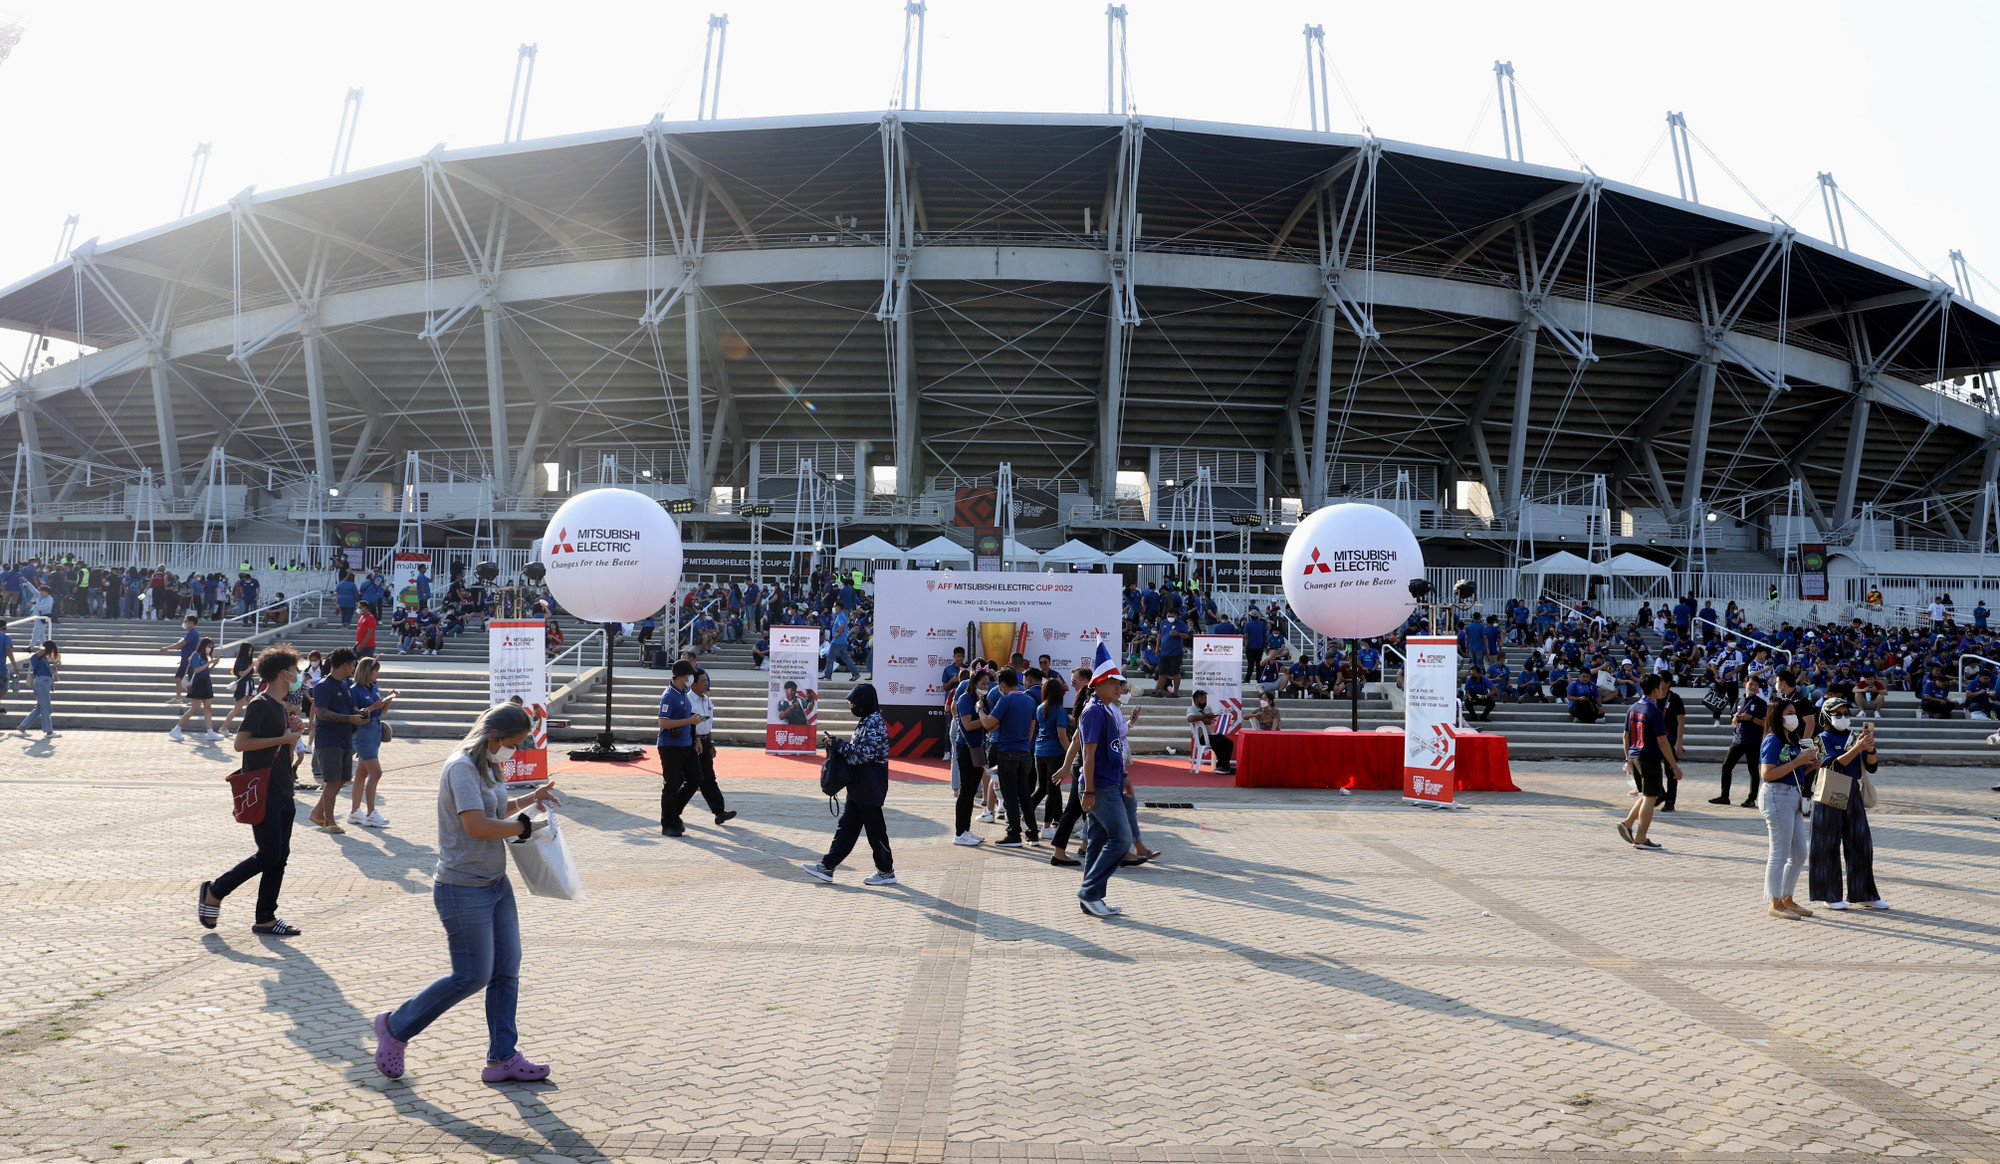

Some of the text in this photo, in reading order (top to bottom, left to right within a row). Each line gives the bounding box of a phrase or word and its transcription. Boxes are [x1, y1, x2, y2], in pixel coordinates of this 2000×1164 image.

[577, 529, 640, 540] MITSUBISHI
[577, 542, 631, 553] ELECTRIC
[1334, 550, 1397, 561] MITSUBISHI
[551, 560, 578, 569] Changes
[580, 559, 592, 567] for
[612, 558, 639, 566] Better
[690, 558, 730, 566] MITSUBISHI
[1334, 561, 1389, 572] ELECTRIC
[1304, 581, 1336, 590] Changes
[1340, 580, 1353, 588] for
[1372, 577, 1397, 586] Better
